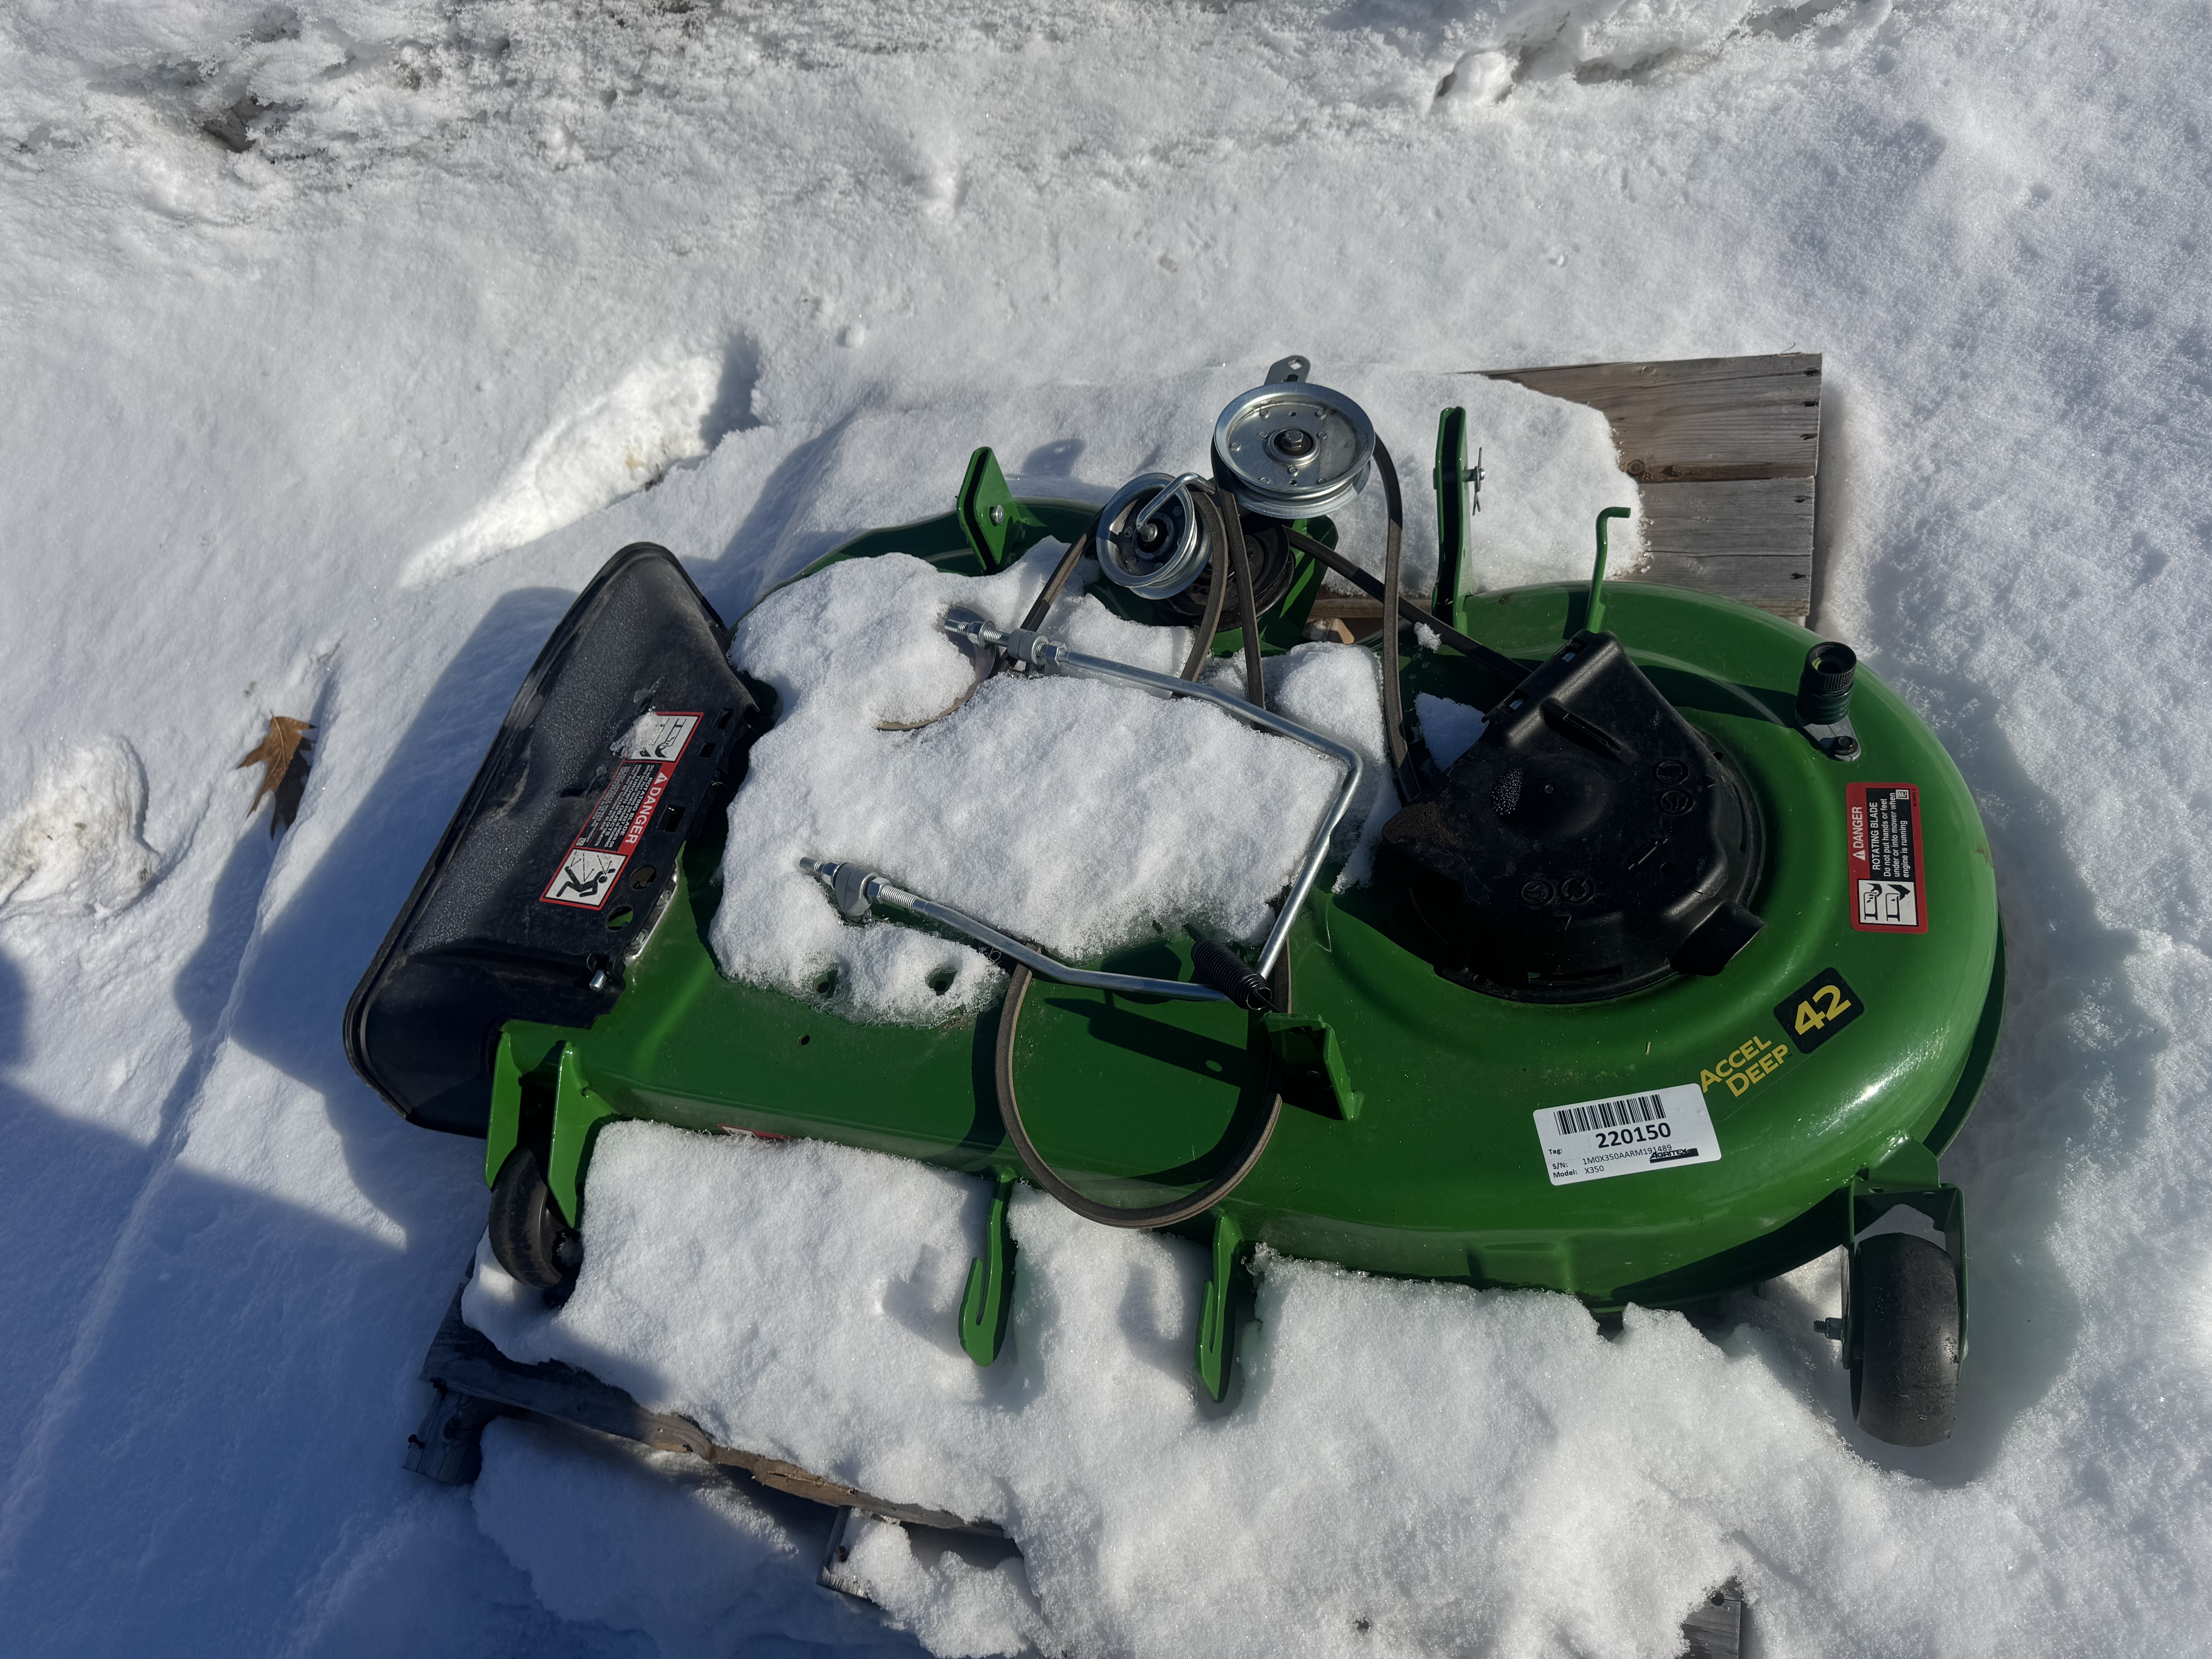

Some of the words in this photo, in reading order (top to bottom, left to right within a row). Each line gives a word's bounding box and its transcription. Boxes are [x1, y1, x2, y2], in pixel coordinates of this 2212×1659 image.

[622, 775, 641, 804] THROWN
[632, 777, 653, 811] ROTATING
[604, 805, 625, 836] OBJECTS
[619, 812, 635, 836] BLADE
[624, 787, 662, 843] DANGER
[1852, 807, 1863, 848] DANGER
[1869, 802, 1878, 828] BLADE
[1899, 821, 1907, 846] running
[1870, 830, 1881, 870] ROTATING
[1882, 843, 1891, 853] put
[1883, 867, 1891, 876] Do
[1901, 855, 1910, 878] engine
[1795, 985, 1851, 1035] 42
[1700, 1036, 1772, 1093] ACCEL
[1595, 1123, 1671, 1149] 220150
[1650, 1148, 1688, 1159] AGRITEX
[1553, 1169, 1577, 1178] Model:
[1585, 1165, 1604, 1174] X350
